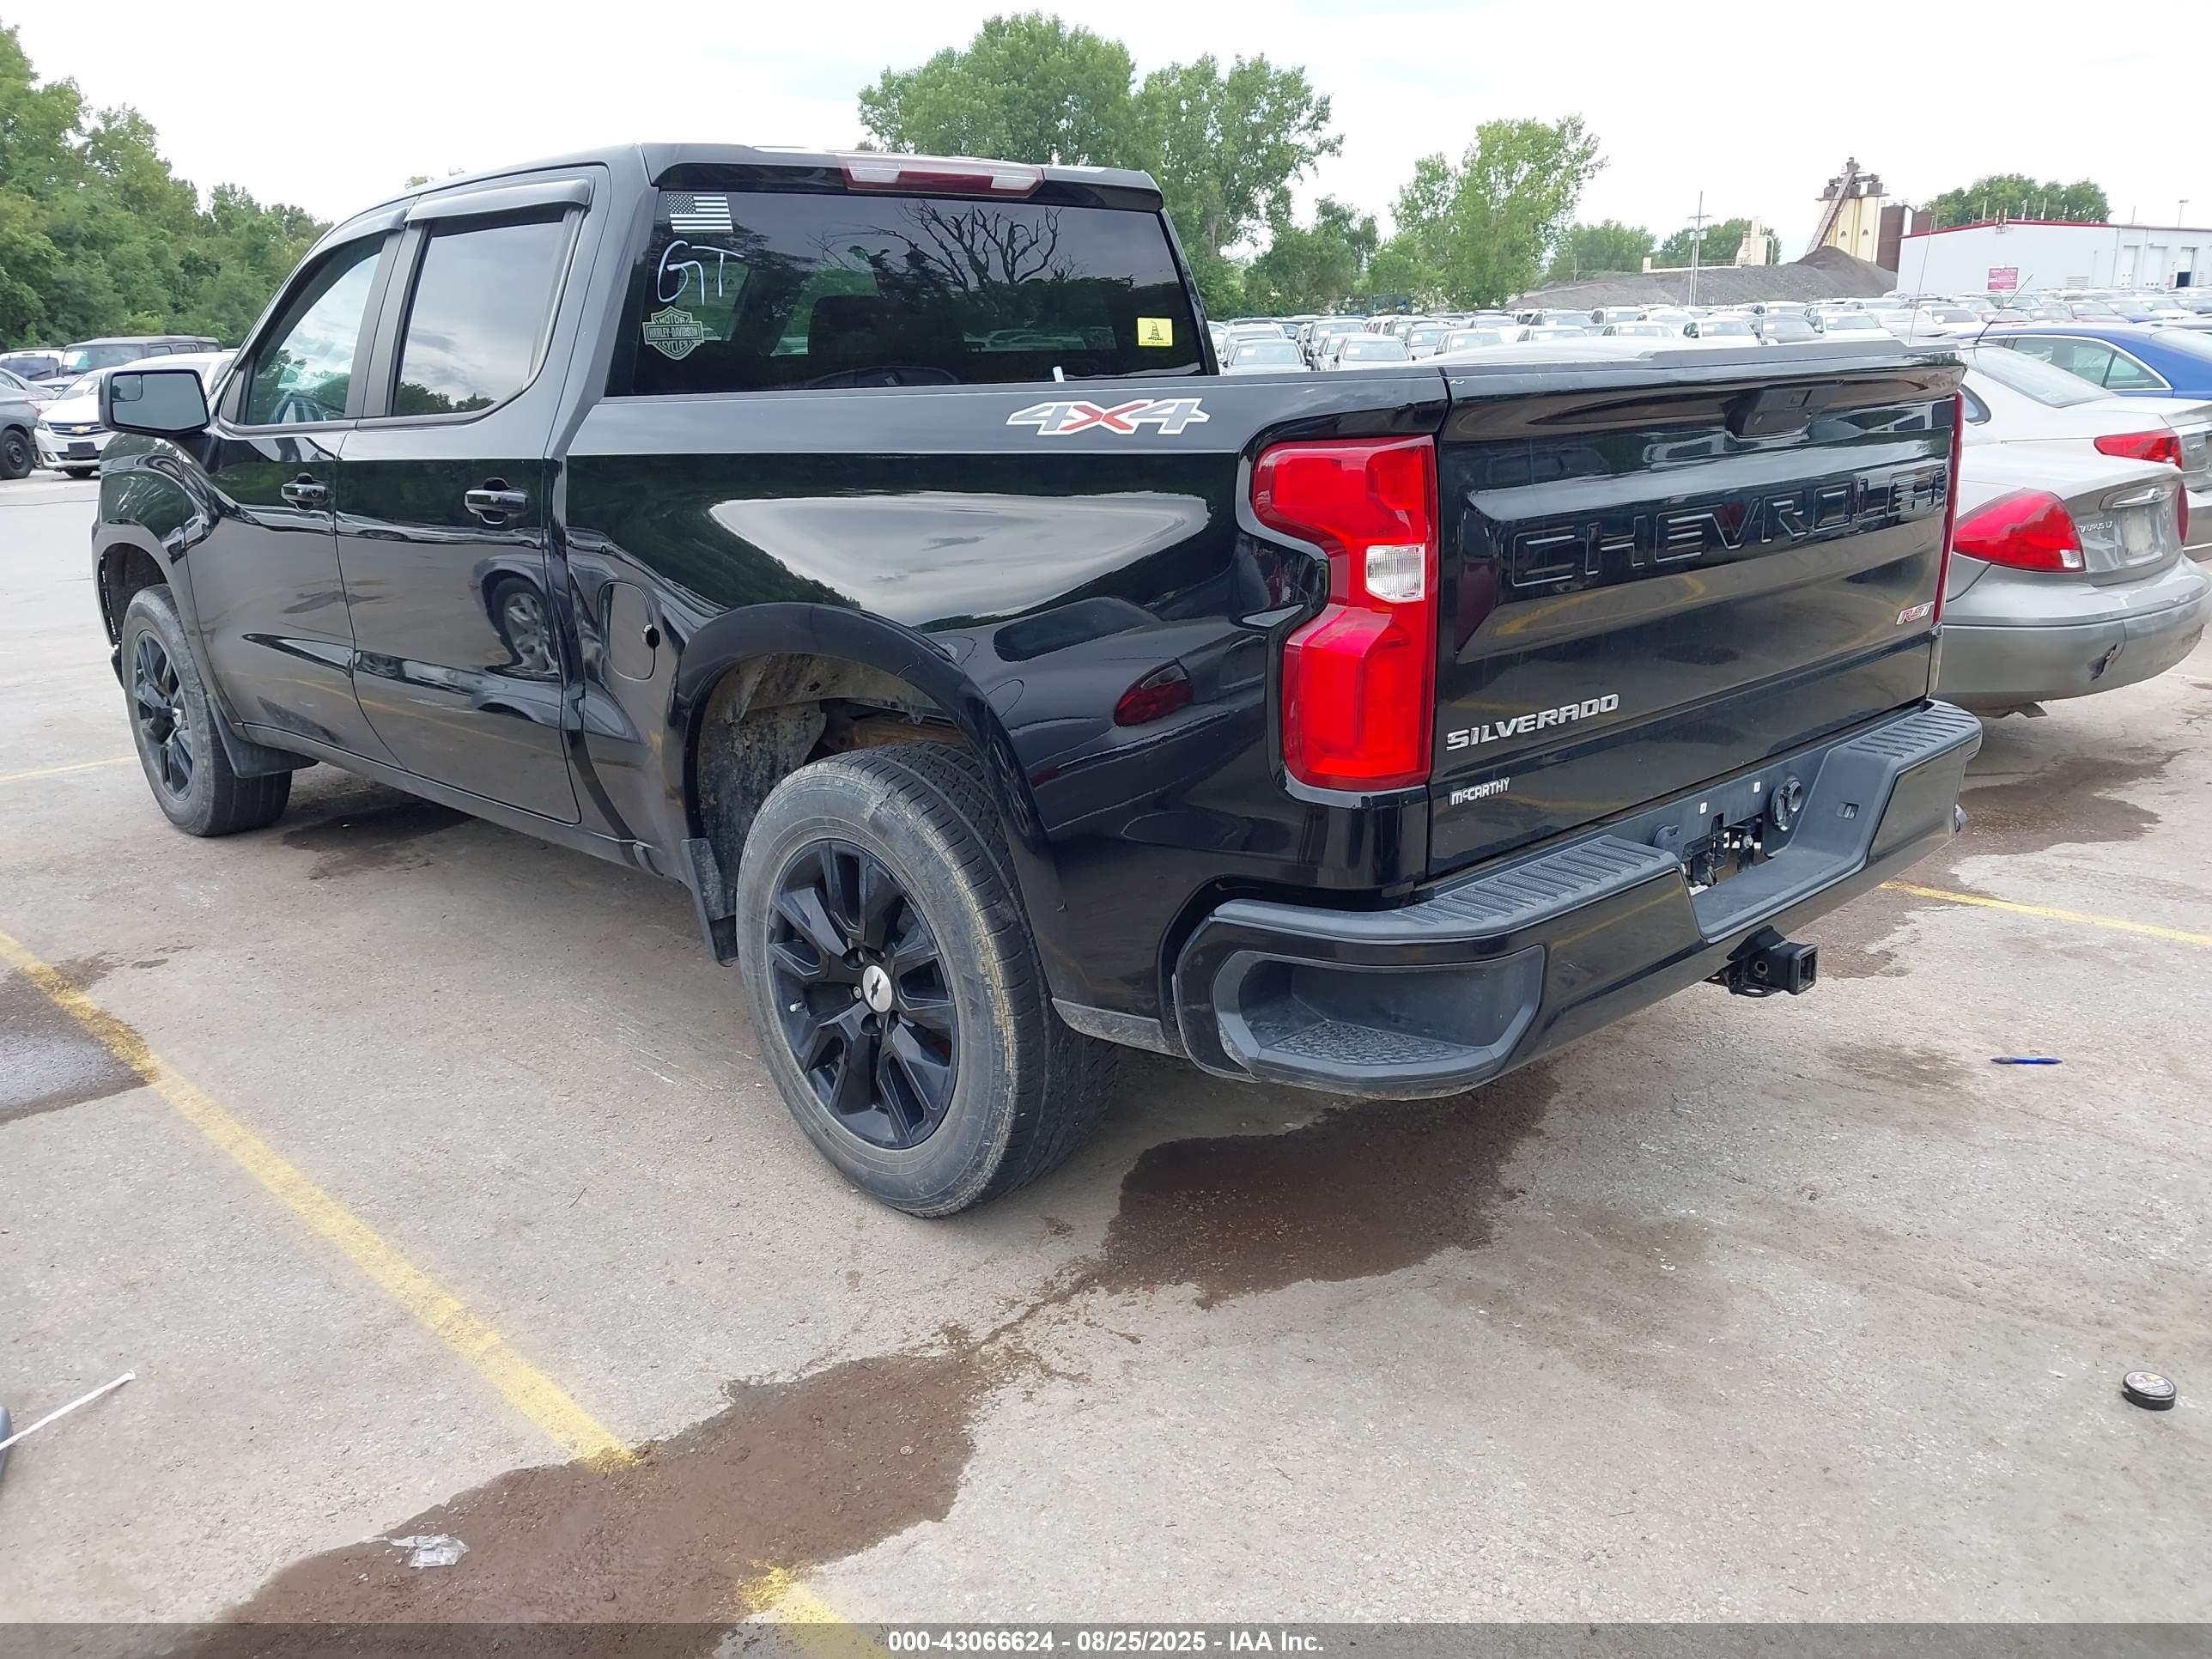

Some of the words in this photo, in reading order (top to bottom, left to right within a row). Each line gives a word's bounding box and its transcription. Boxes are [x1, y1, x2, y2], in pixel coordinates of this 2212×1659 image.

[659, 313, 685, 324] MOTOR
[648, 327, 698, 337] HARLEY-DAVIDSON
[661, 340, 689, 353] CYCLES
[1896, 601, 1935, 625] RST
[1446, 694, 1620, 751] SILVERADO
